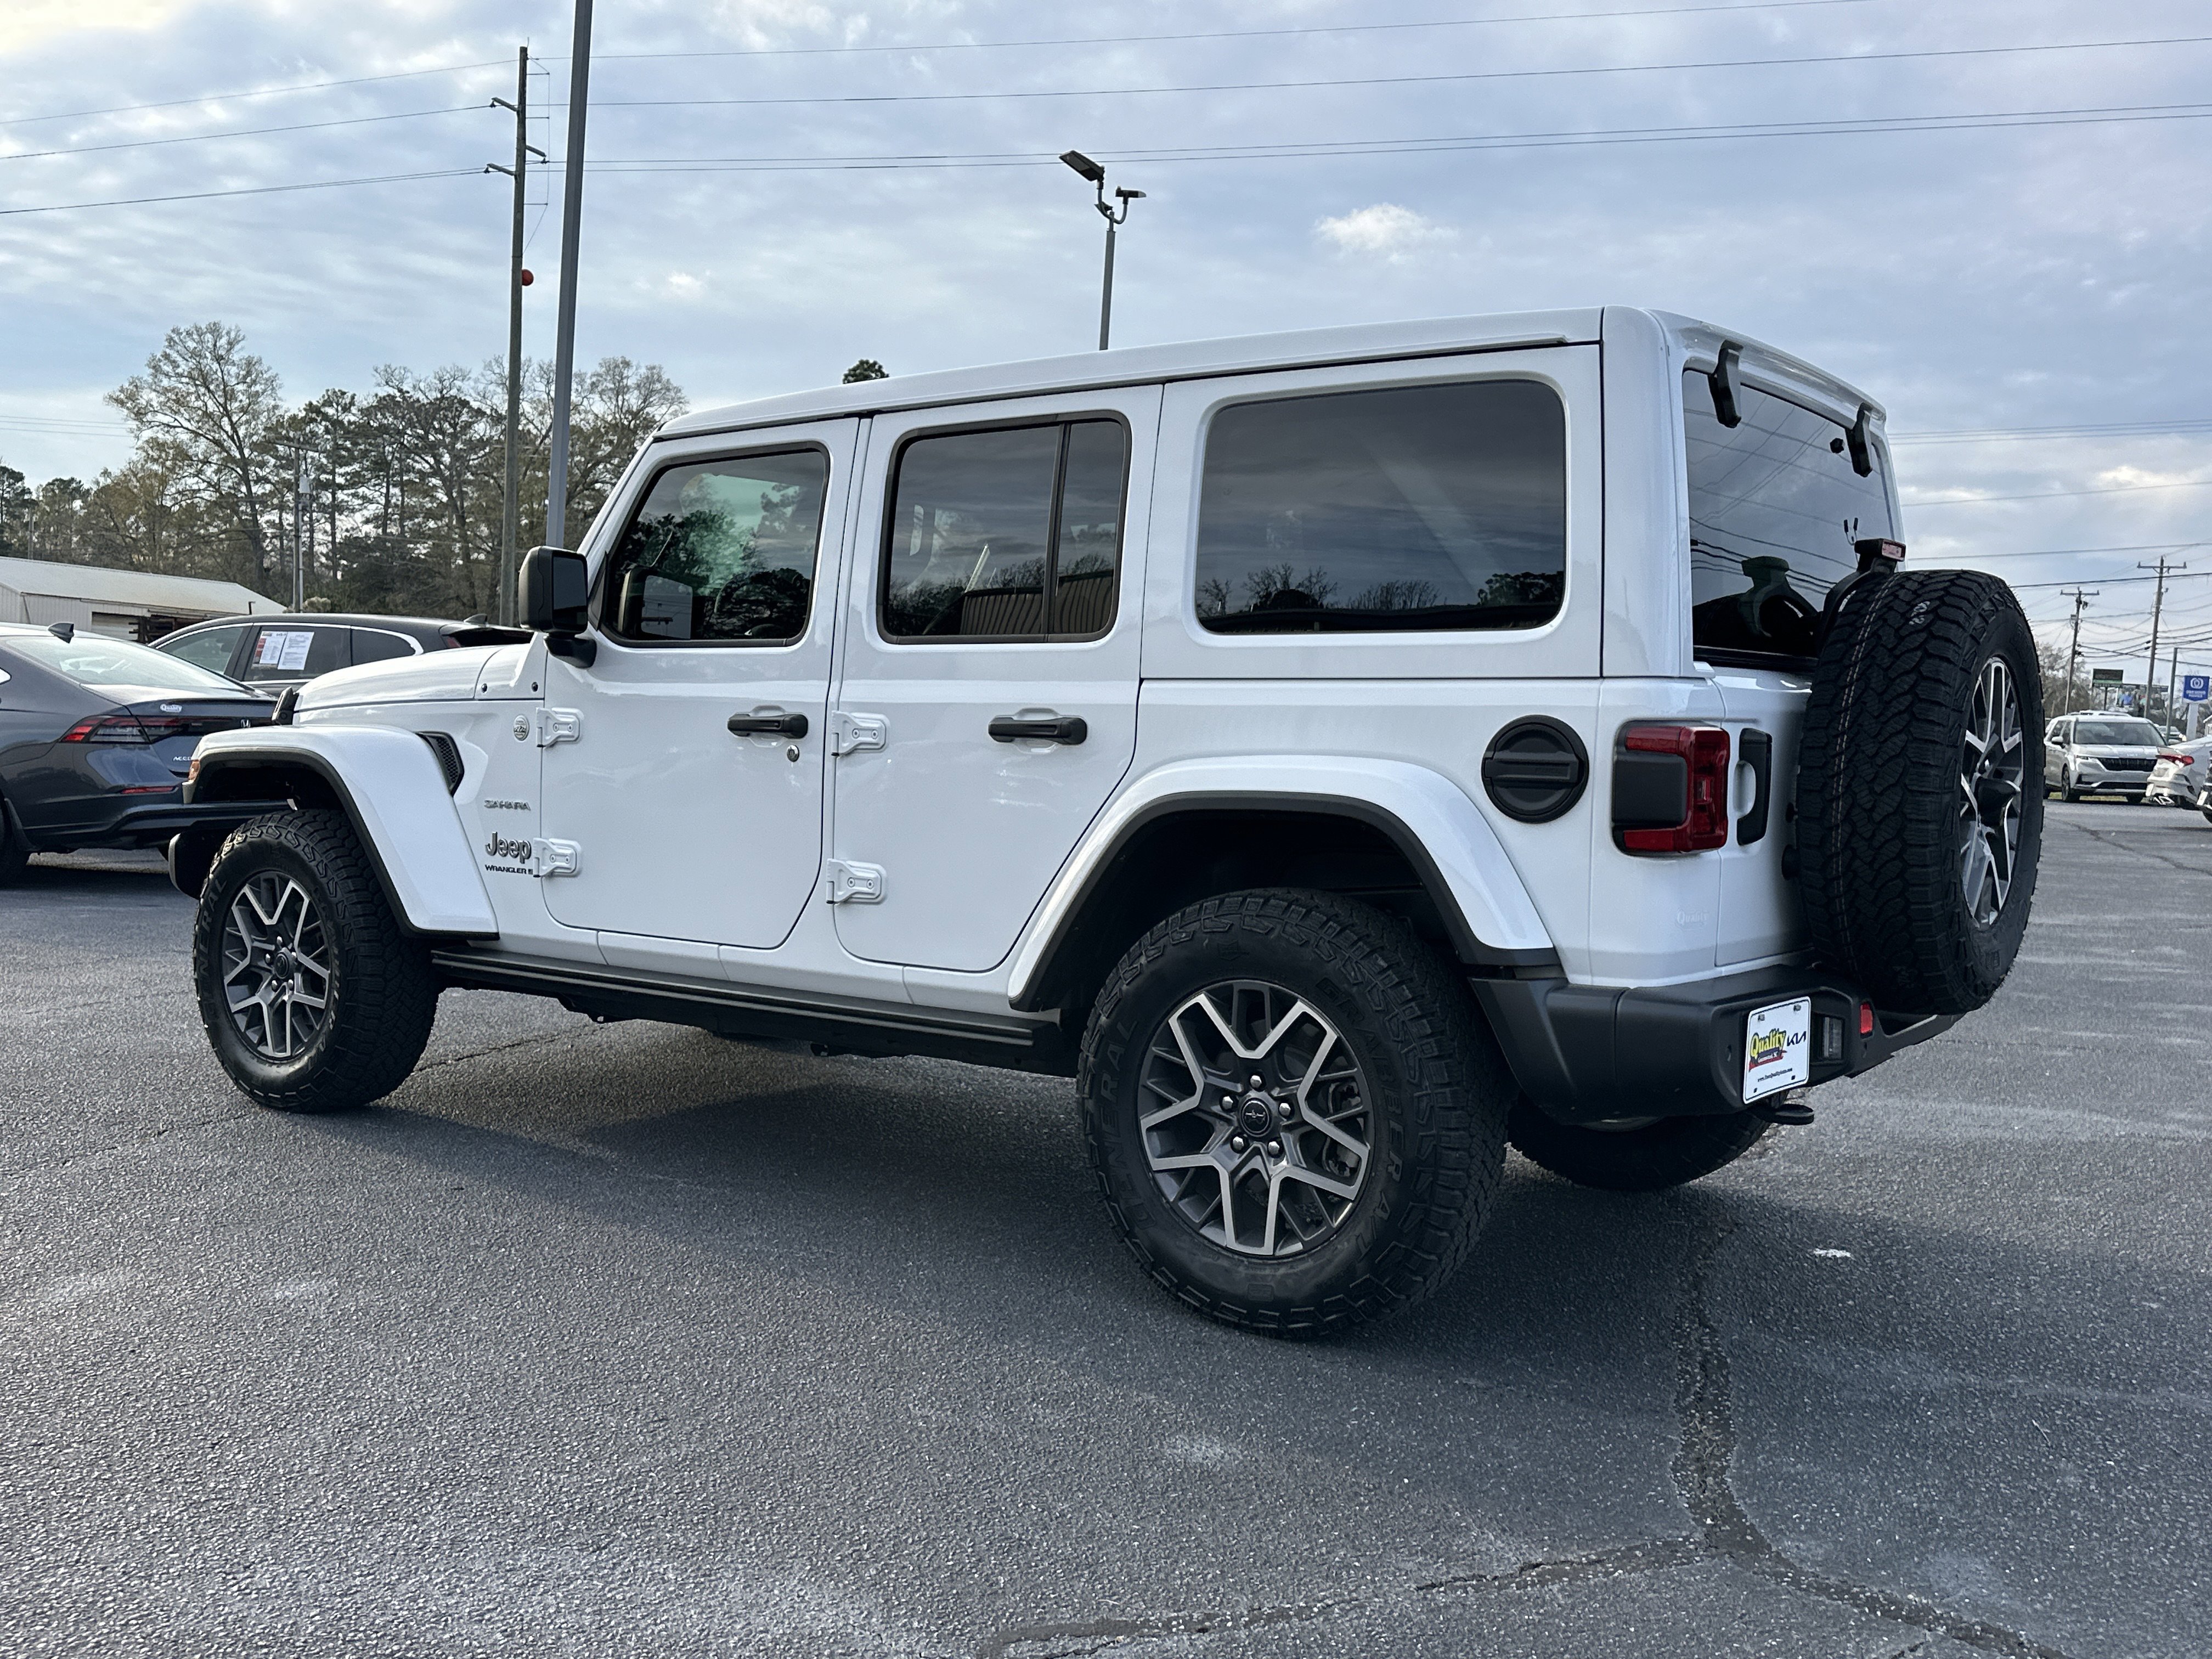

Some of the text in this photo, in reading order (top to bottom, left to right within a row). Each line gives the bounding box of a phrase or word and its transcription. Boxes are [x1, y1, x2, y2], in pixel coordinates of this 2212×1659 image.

[484, 800, 531, 811] SAHARA
[485, 831, 532, 864] Jeep
[485, 865, 527, 874] WRANGLER
[1750, 1028, 1786, 1059] Quality
[1787, 1031, 1807, 1046] KIA
